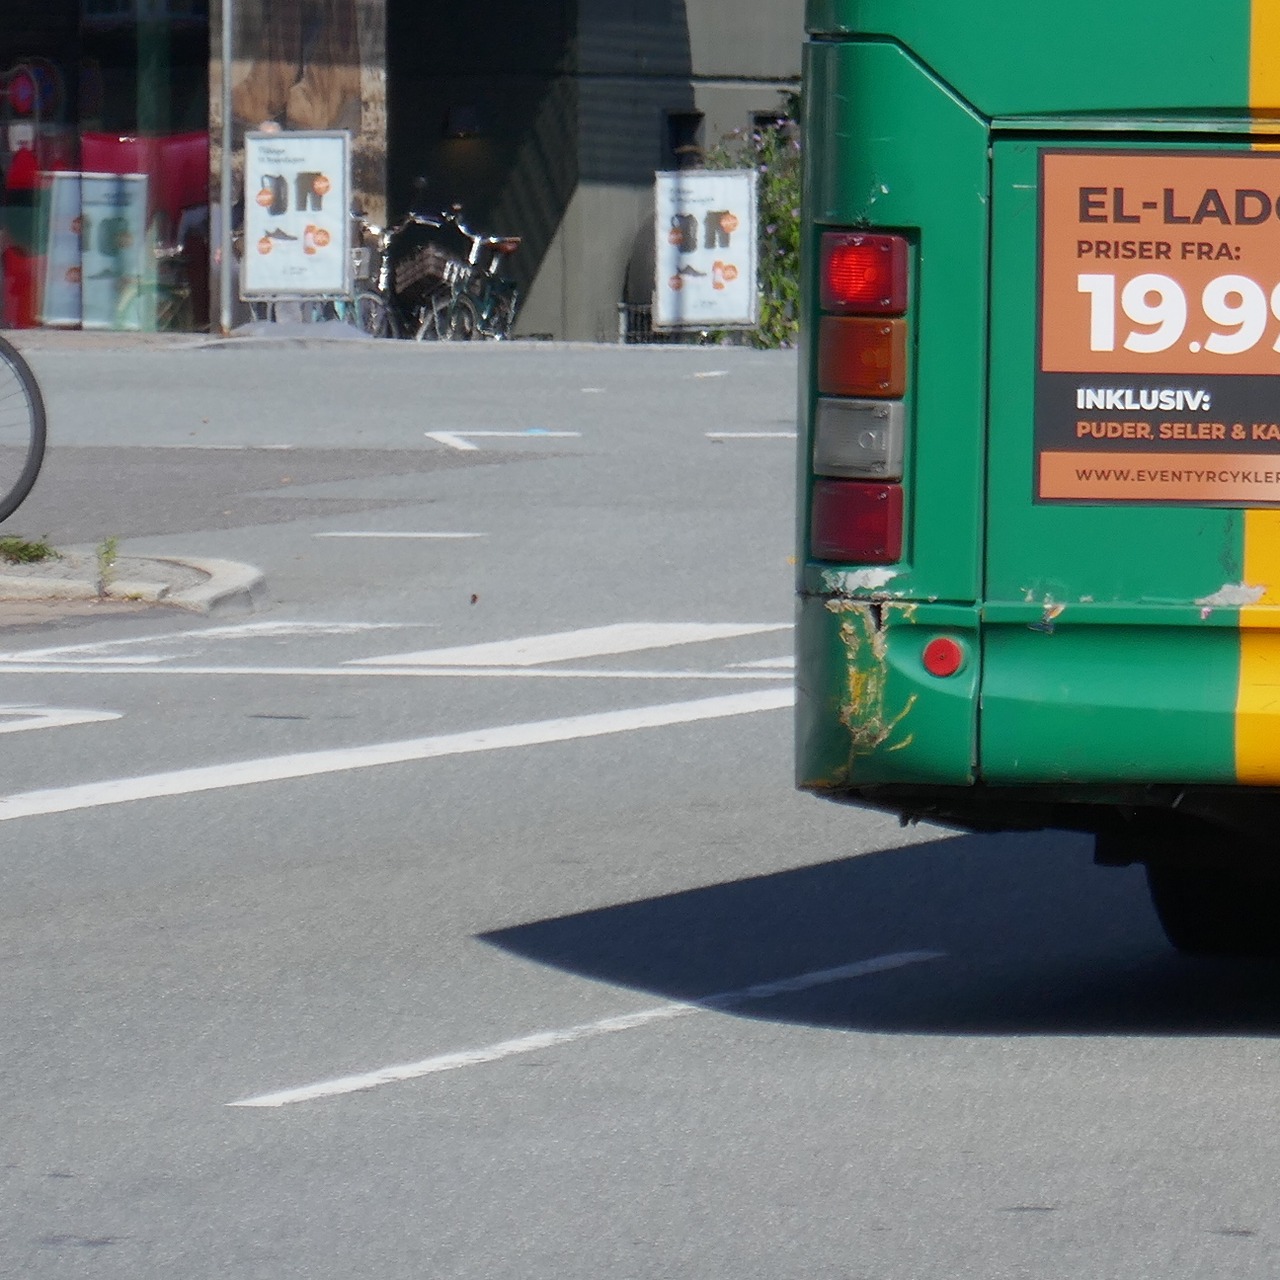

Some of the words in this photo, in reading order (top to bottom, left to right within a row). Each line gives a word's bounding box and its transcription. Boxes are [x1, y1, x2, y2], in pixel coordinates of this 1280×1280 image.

[1076, 239, 1172, 260] PRISER
[1180, 241, 1241, 262] FRA:
[1076, 388, 1211, 411] INKLUSIV:
[1076, 421, 1155, 441] PUDER,
[1159, 422, 1225, 440] SELER
[1230, 423, 1246, 440] &
